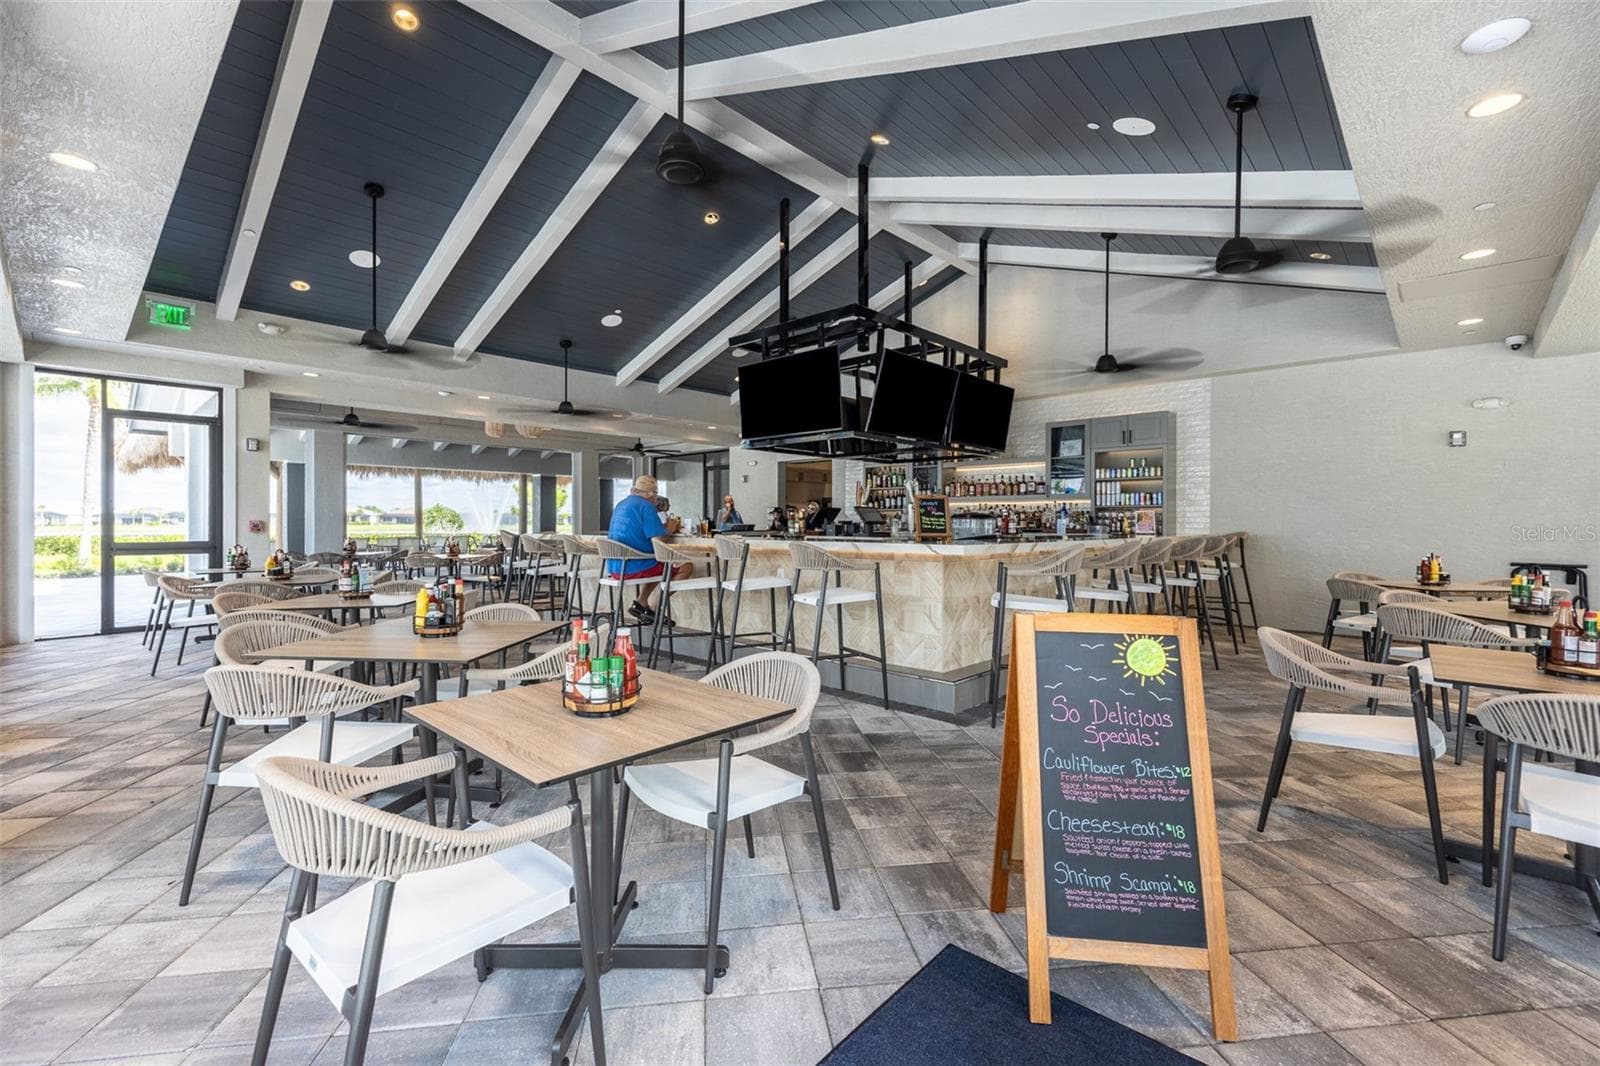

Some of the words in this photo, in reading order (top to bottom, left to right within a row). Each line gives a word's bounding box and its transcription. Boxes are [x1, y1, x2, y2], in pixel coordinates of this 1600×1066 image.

[155, 303, 185, 325] EXIT
[1050, 695, 1081, 723] So
[1089, 699, 1174, 728] Delicious
[1084, 725, 1160, 752] Specials:
[1043, 747, 1126, 776] Cauliflower
[1131, 758, 1178, 779] Bites:
[1060, 771, 1083, 781] Fried
[1047, 809, 1165, 838] Cheesesteak:
[1054, 861, 1112, 891] Shrimp
[1119, 873, 1178, 897] Scampi:
